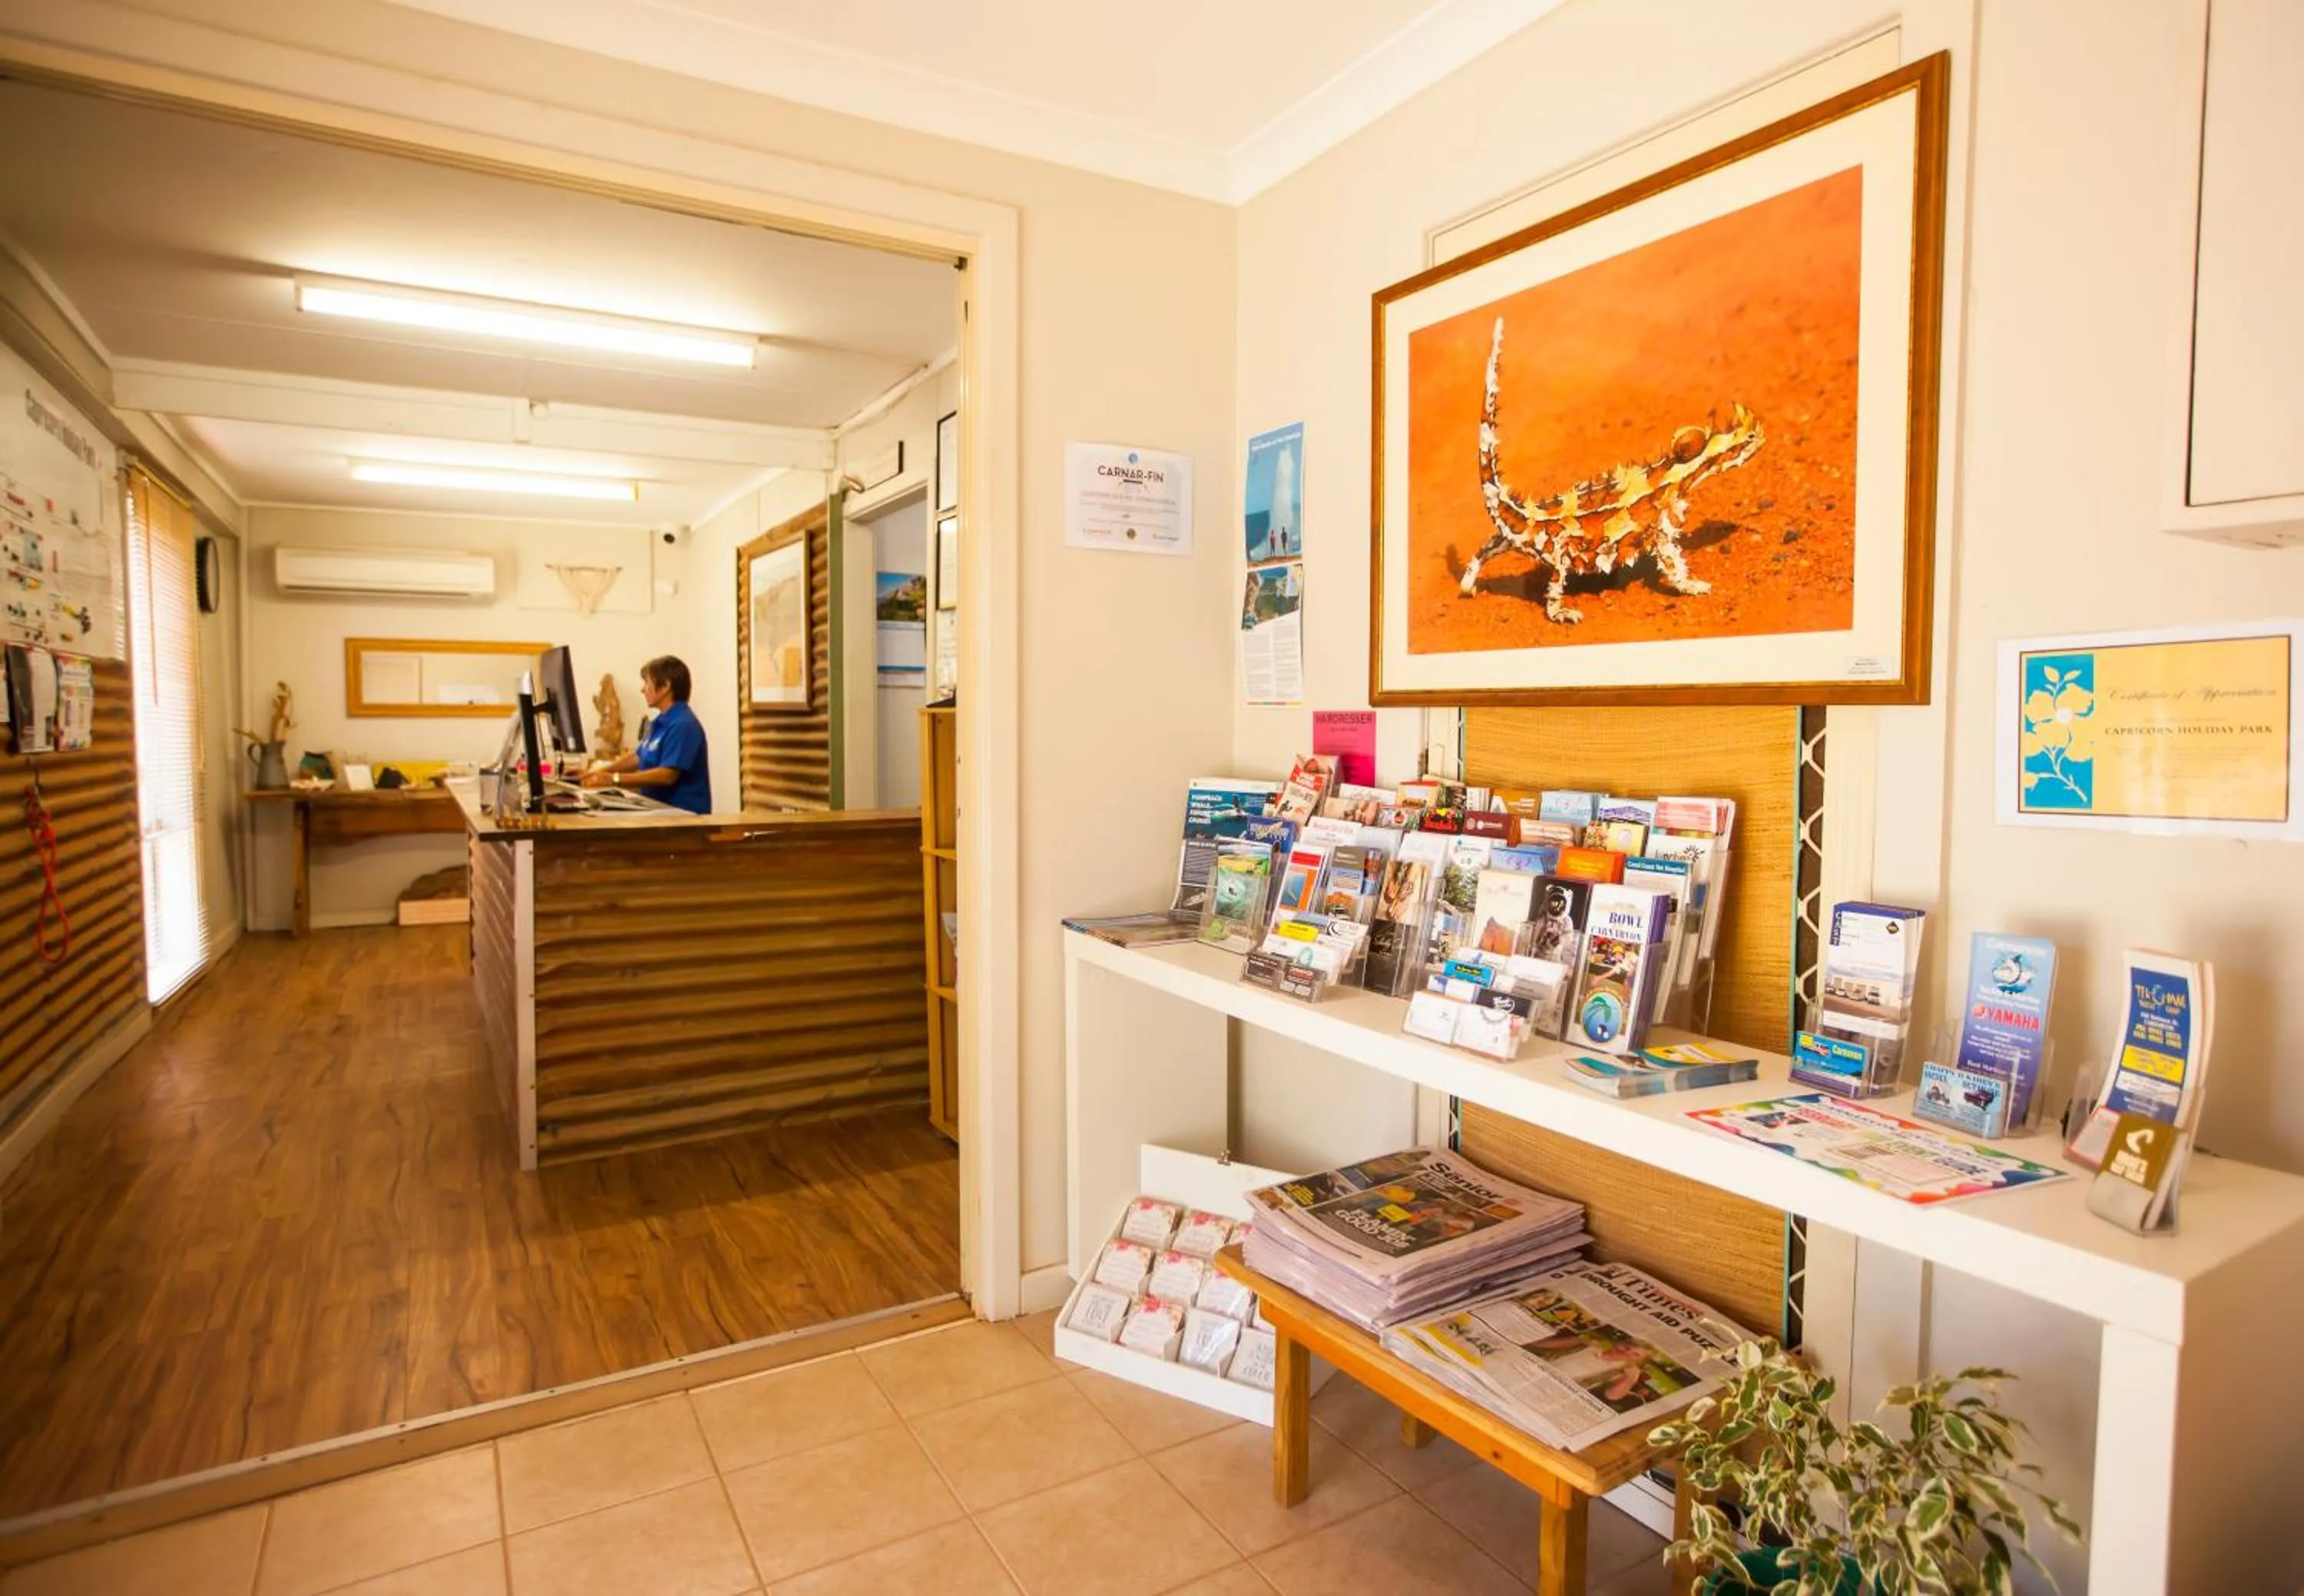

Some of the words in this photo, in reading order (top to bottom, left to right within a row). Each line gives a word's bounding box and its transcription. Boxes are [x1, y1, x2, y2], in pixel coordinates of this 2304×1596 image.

[1097, 465, 1164, 482] CARNAR-FIN
[2104, 727, 2173, 735] CAPRICORN
[2178, 726, 2234, 734] HOLIDAY
[2239, 725, 2273, 733] PARK
[1609, 912, 1644, 929] BOWL
[1988, 1007, 2041, 1031] YAMAHA
[1430, 1162, 1503, 1198] Senior
[1336, 1210, 1380, 1234] GOOD
[1624, 1273, 1697, 1320] Times
[1580, 1273, 1651, 1313] DROUGHT
[1650, 1311, 1681, 1328] AID
[1680, 1328, 1740, 1368] PUZLE
